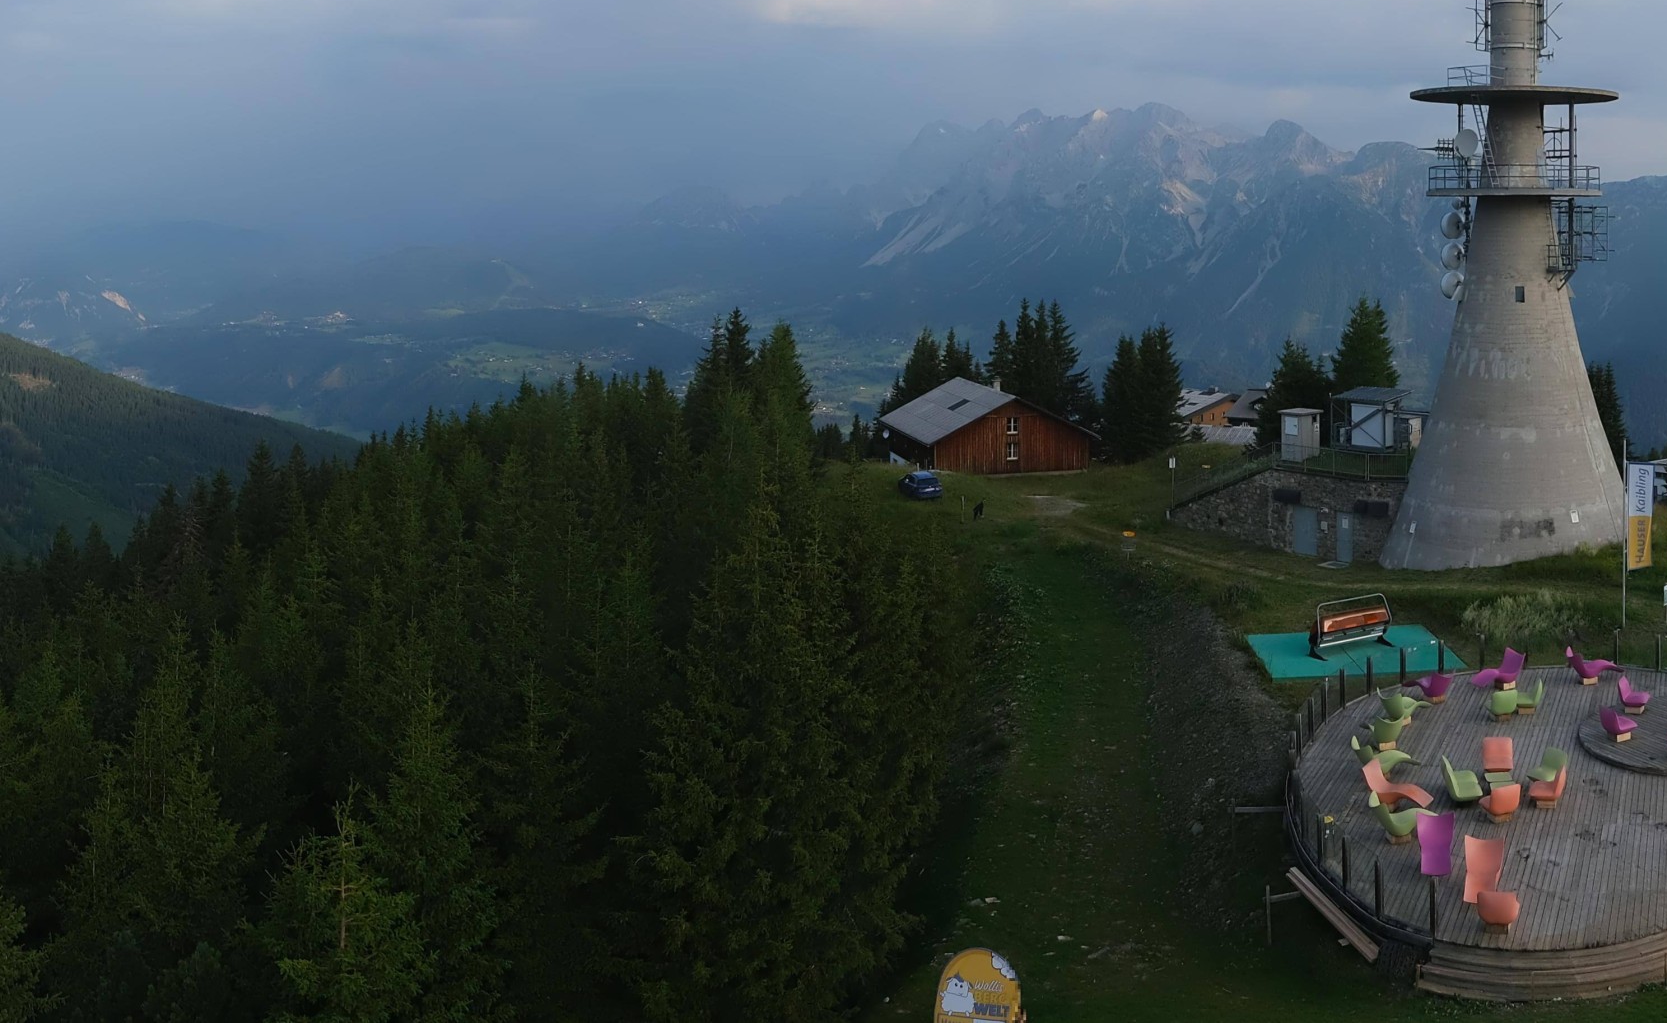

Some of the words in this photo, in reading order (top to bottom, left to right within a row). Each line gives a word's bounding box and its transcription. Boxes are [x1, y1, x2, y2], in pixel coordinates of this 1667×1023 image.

[1636, 468, 1649, 513] Kaibling
[1635, 519, 1646, 564] HAUSER
[974, 1003, 1010, 1017] WELT
